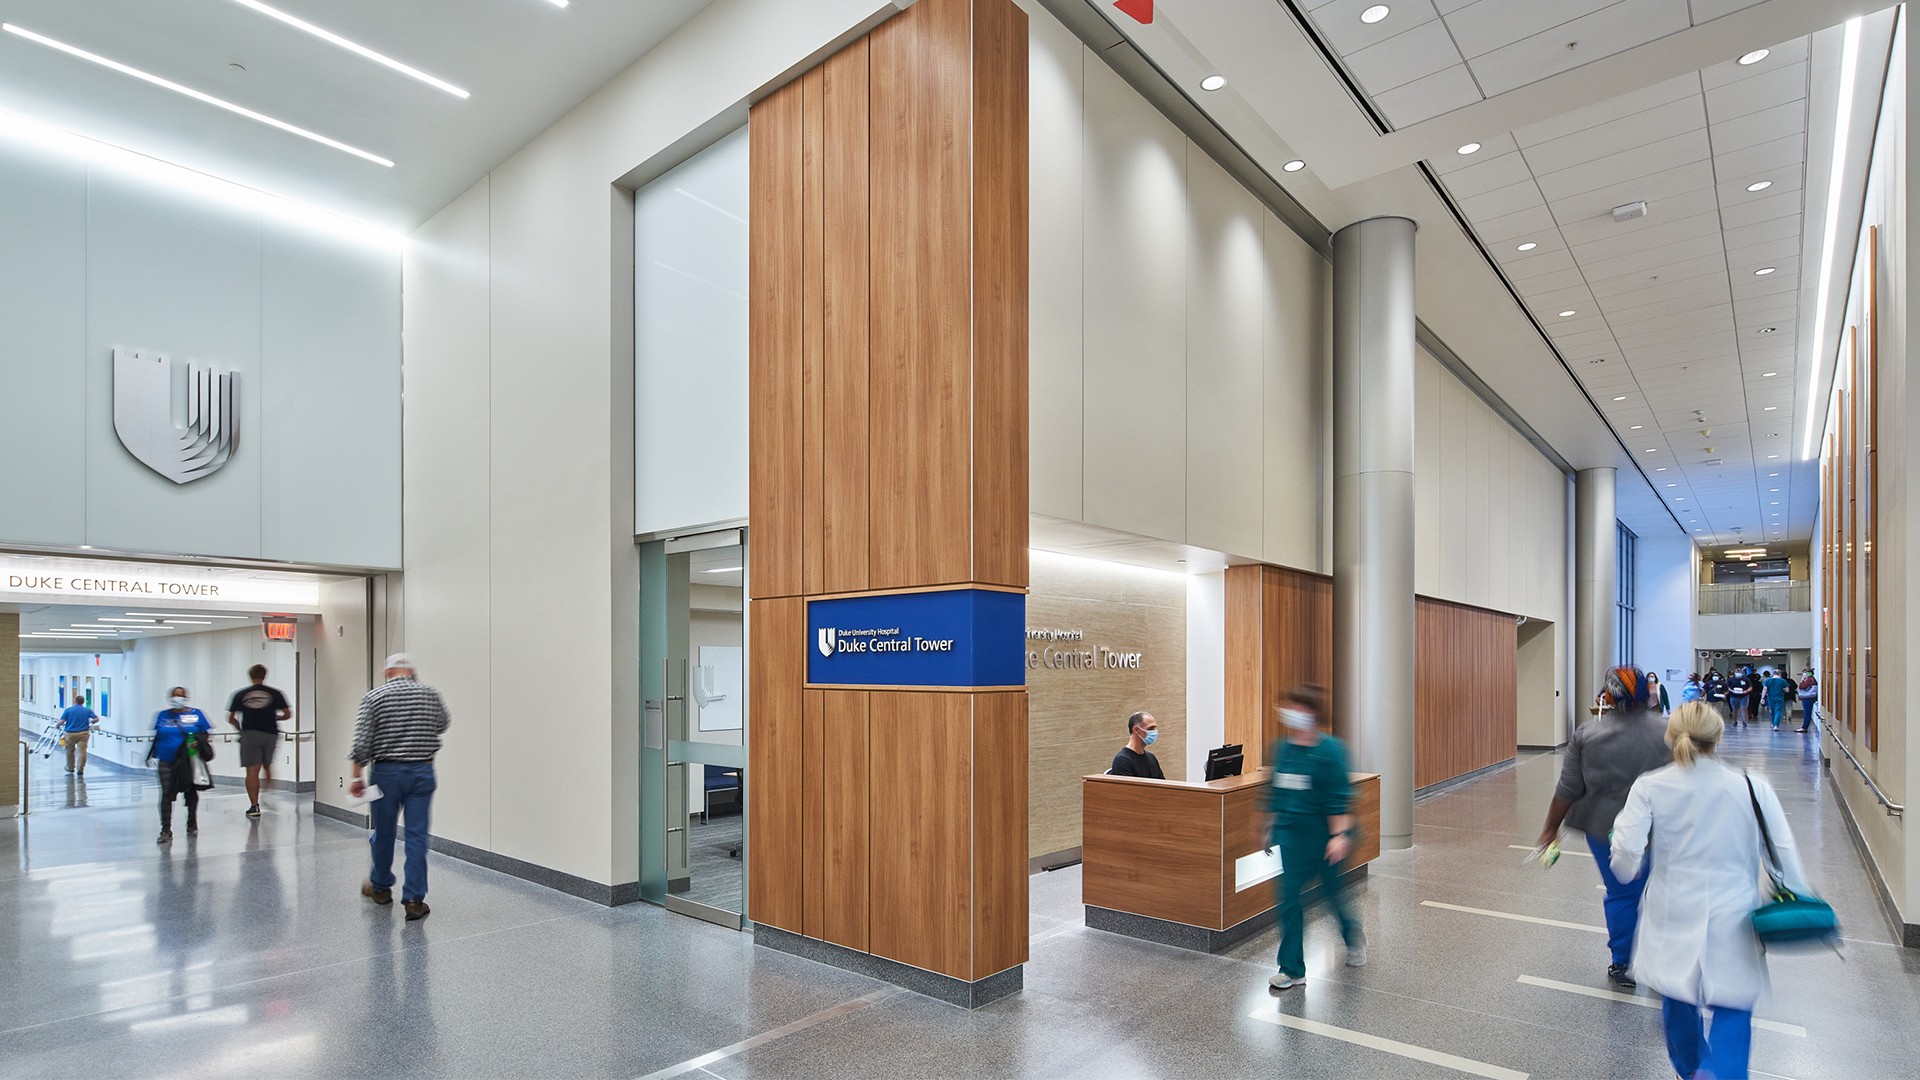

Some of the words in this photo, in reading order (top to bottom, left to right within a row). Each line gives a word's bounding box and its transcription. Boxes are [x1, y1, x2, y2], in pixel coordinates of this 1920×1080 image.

[9, 575, 63, 589] DUKE
[70, 578, 153, 593] CENTRAL
[158, 582, 219, 596] TOWER
[269, 623, 290, 638] EXIT
[851, 628, 877, 636] University
[877, 627, 899, 635] Hospital
[1025, 627, 1053, 642] iversity
[1054, 629, 1083, 643] Hospital
[838, 639, 866, 652] Duke
[869, 636, 911, 652] Central
[914, 636, 953, 651] Tower
[1042, 644, 1097, 669] Central
[1100, 647, 1142, 669] Tower
